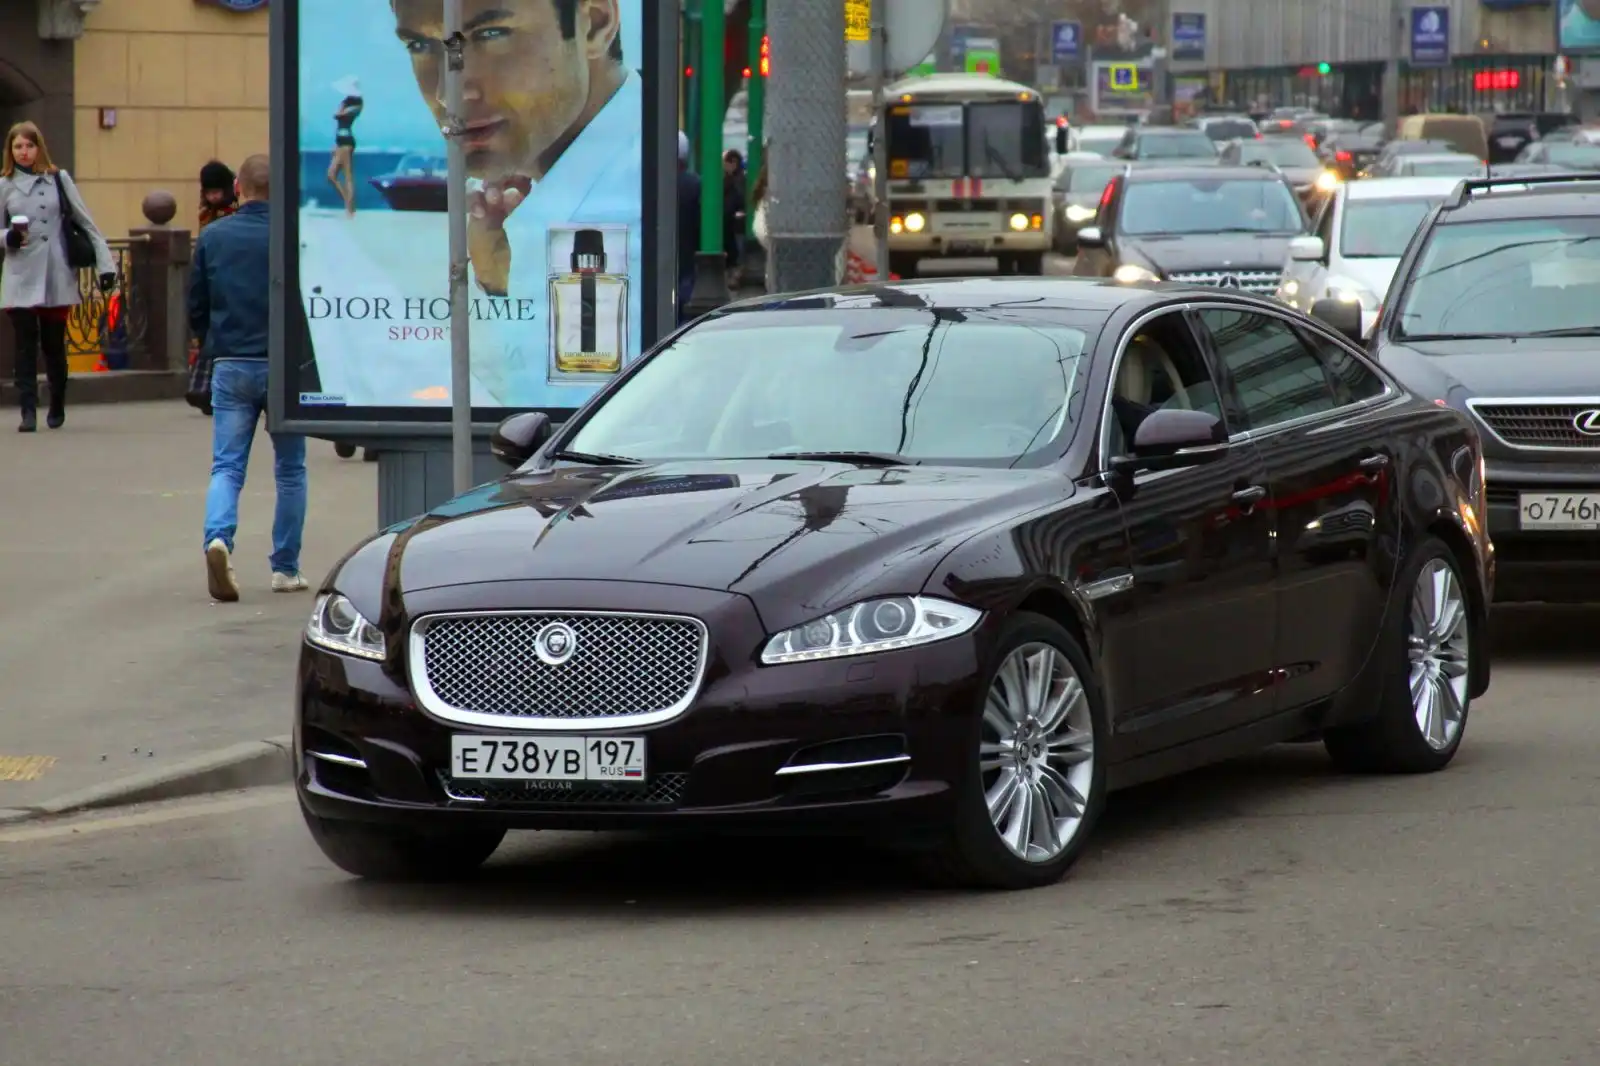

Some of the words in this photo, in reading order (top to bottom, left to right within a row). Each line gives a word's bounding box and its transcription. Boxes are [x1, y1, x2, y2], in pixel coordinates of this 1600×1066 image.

[308, 297, 393, 320] DIOR
[388, 326, 451, 341] SPOR
[590, 740, 635, 766] 197
[600, 766, 624, 776] RUS
[524, 781, 573, 790] JAGUAR
